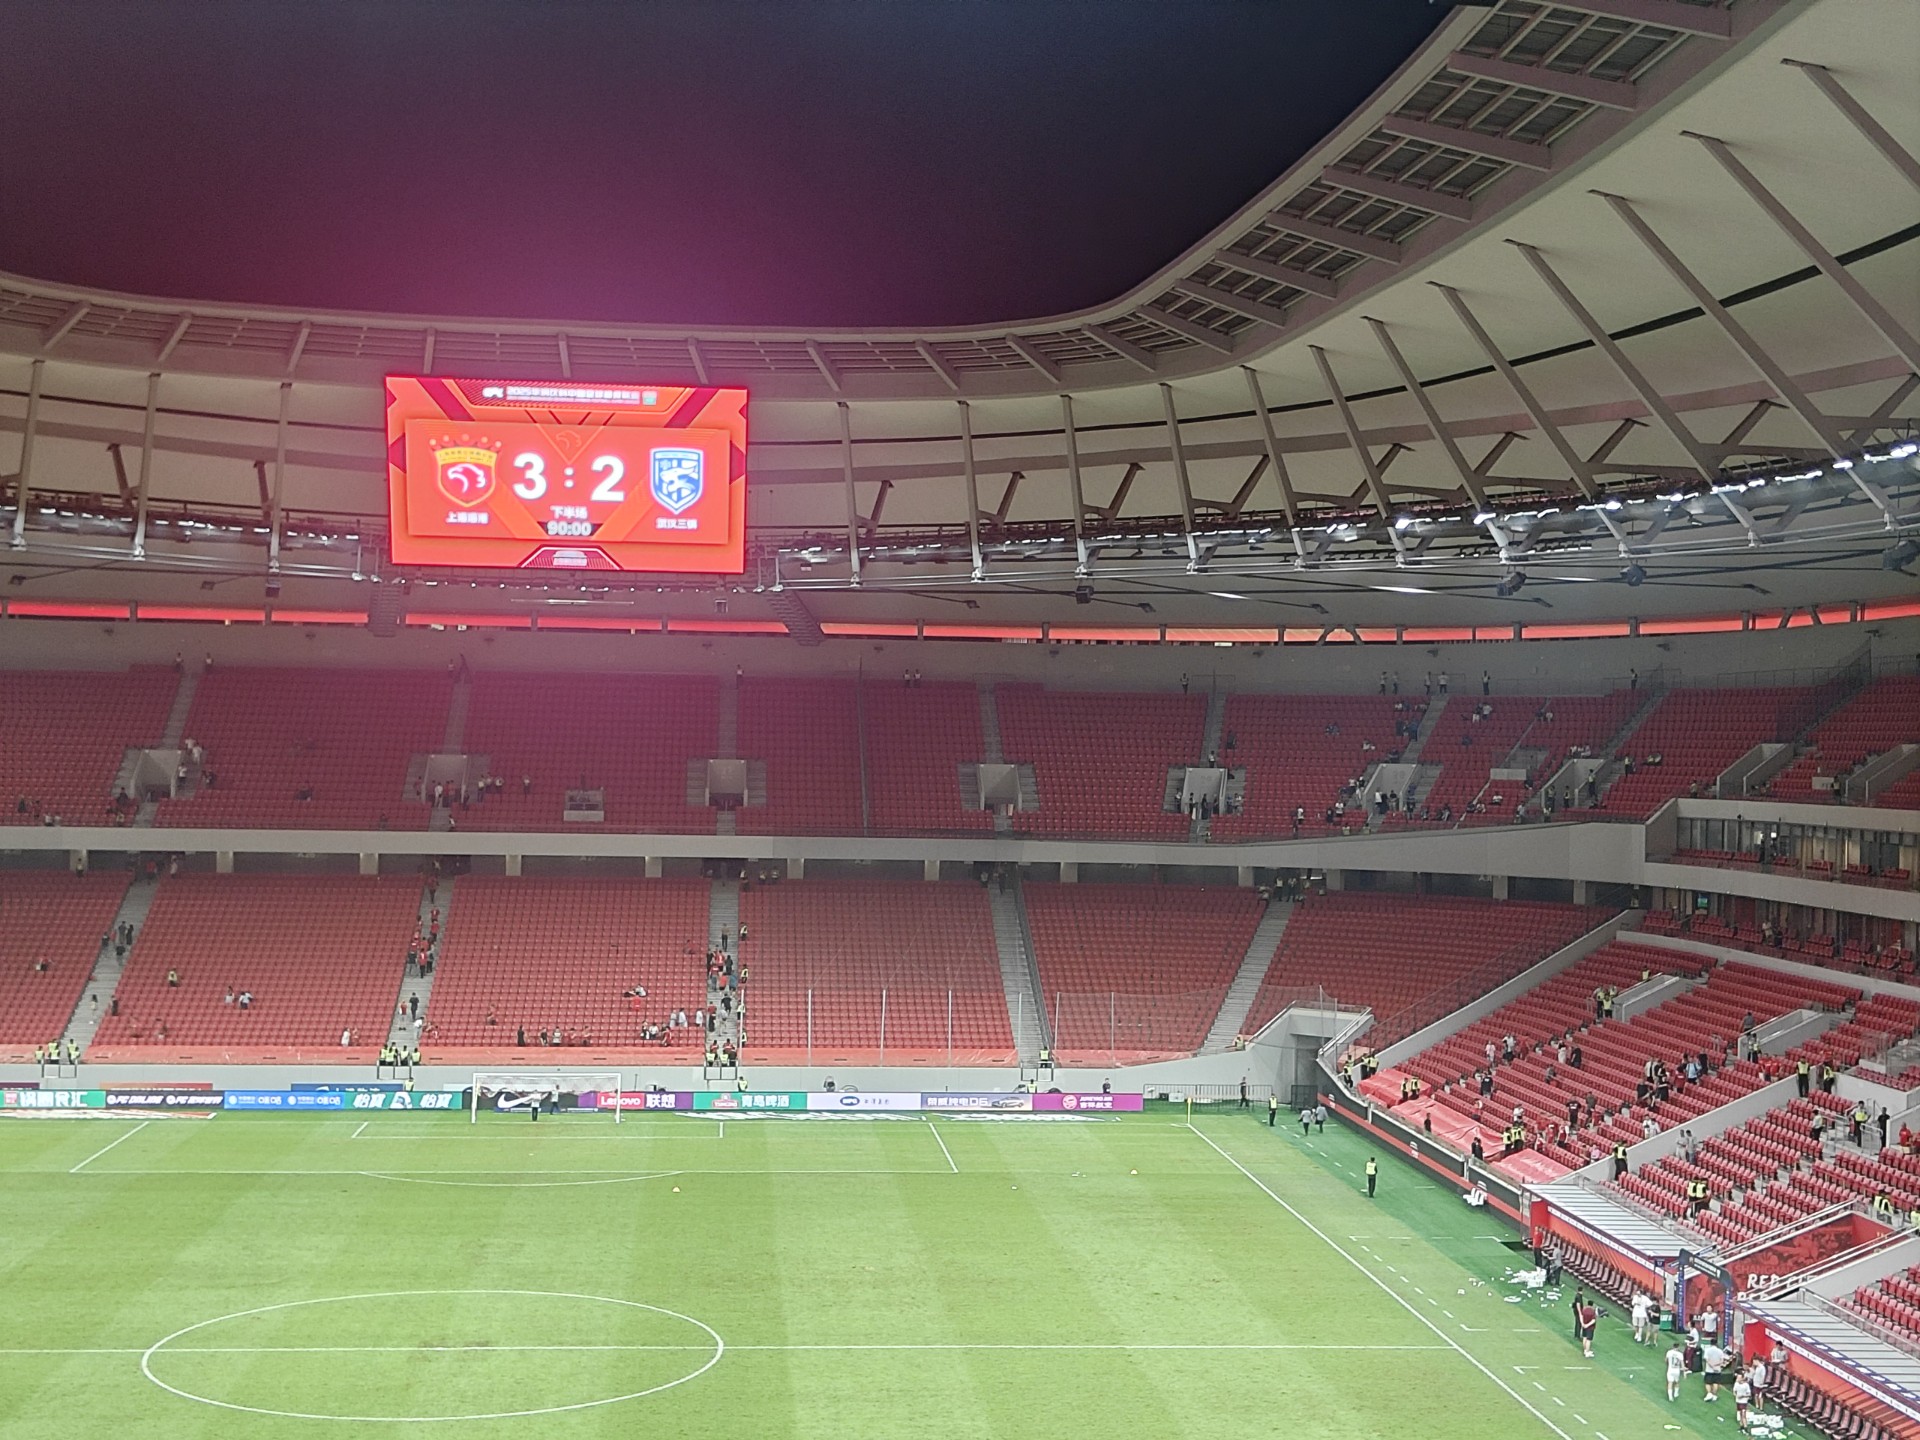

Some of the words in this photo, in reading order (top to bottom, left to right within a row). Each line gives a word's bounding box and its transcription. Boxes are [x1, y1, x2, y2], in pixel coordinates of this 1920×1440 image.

[513, 453, 547, 500] 3
[590, 456, 625, 502] 2
[549, 505, 588, 519] 下半场
[547, 521, 592, 536] 90:00
[645, 1093, 676, 1108] 联想
[741, 1094, 790, 1108] 青岛啤酒
